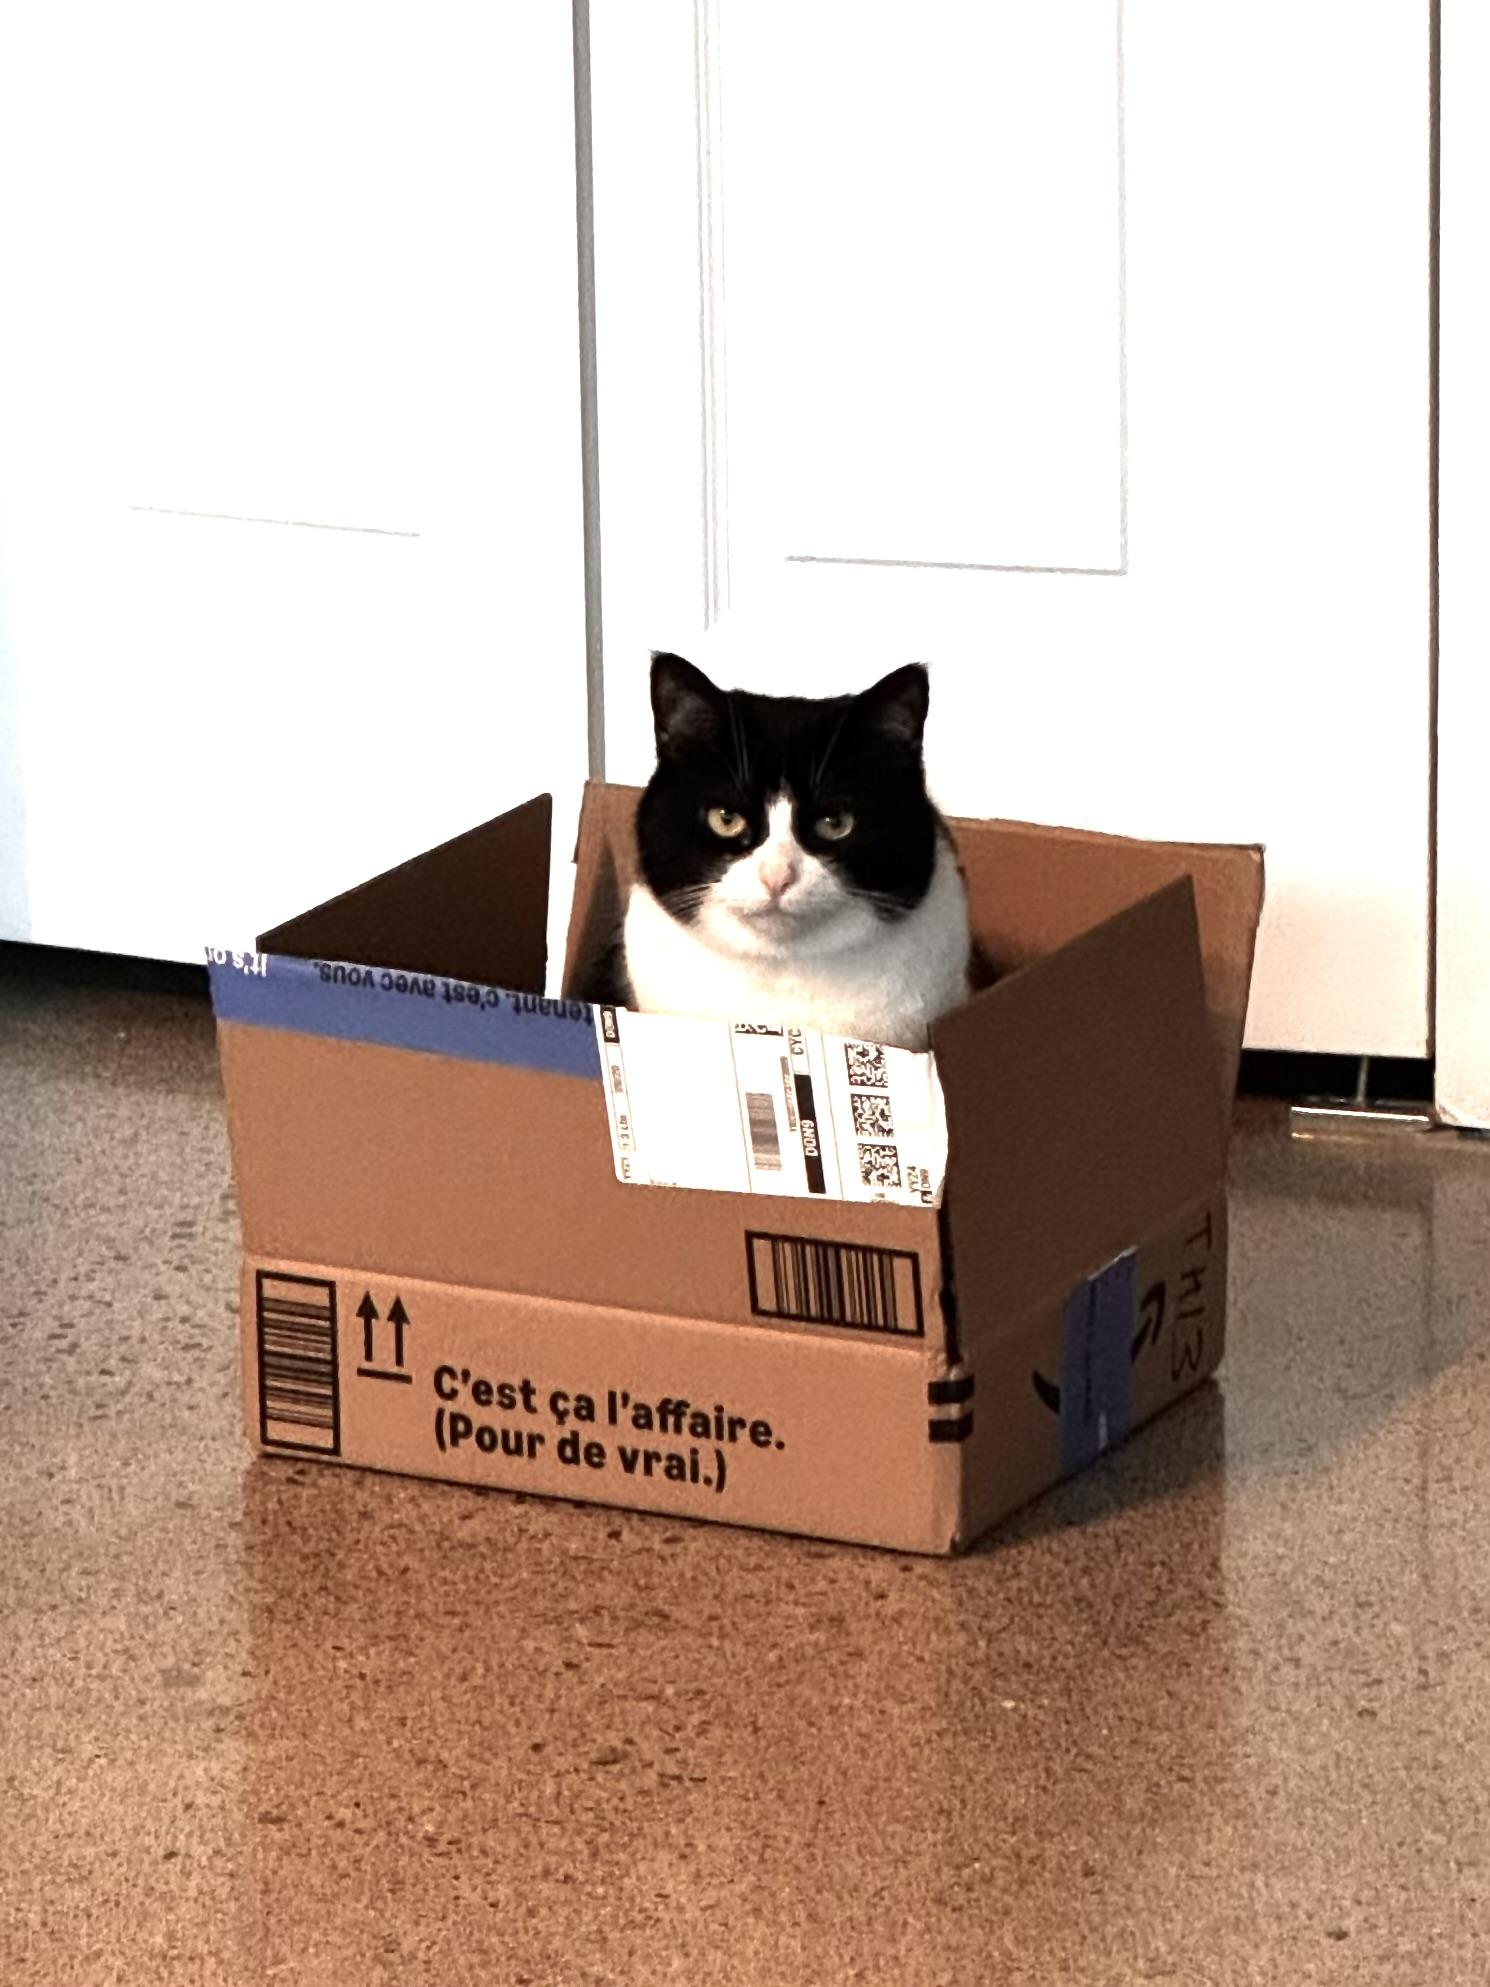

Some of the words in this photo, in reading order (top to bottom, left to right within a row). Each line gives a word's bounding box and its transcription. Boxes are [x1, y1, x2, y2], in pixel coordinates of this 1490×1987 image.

[313, 961, 376, 990] vous.
[381, 972, 437, 999] avec
[441, 981, 500, 1011] c'est
[433, 1364, 538, 1414] C'est
[549, 1390, 595, 1425] ça
[607, 1389, 785, 1450] l'affaire.
[434, 1407, 546, 1459] (Pour
[556, 1430, 607, 1469] de
[617, 1445, 727, 1494] vrai.)
